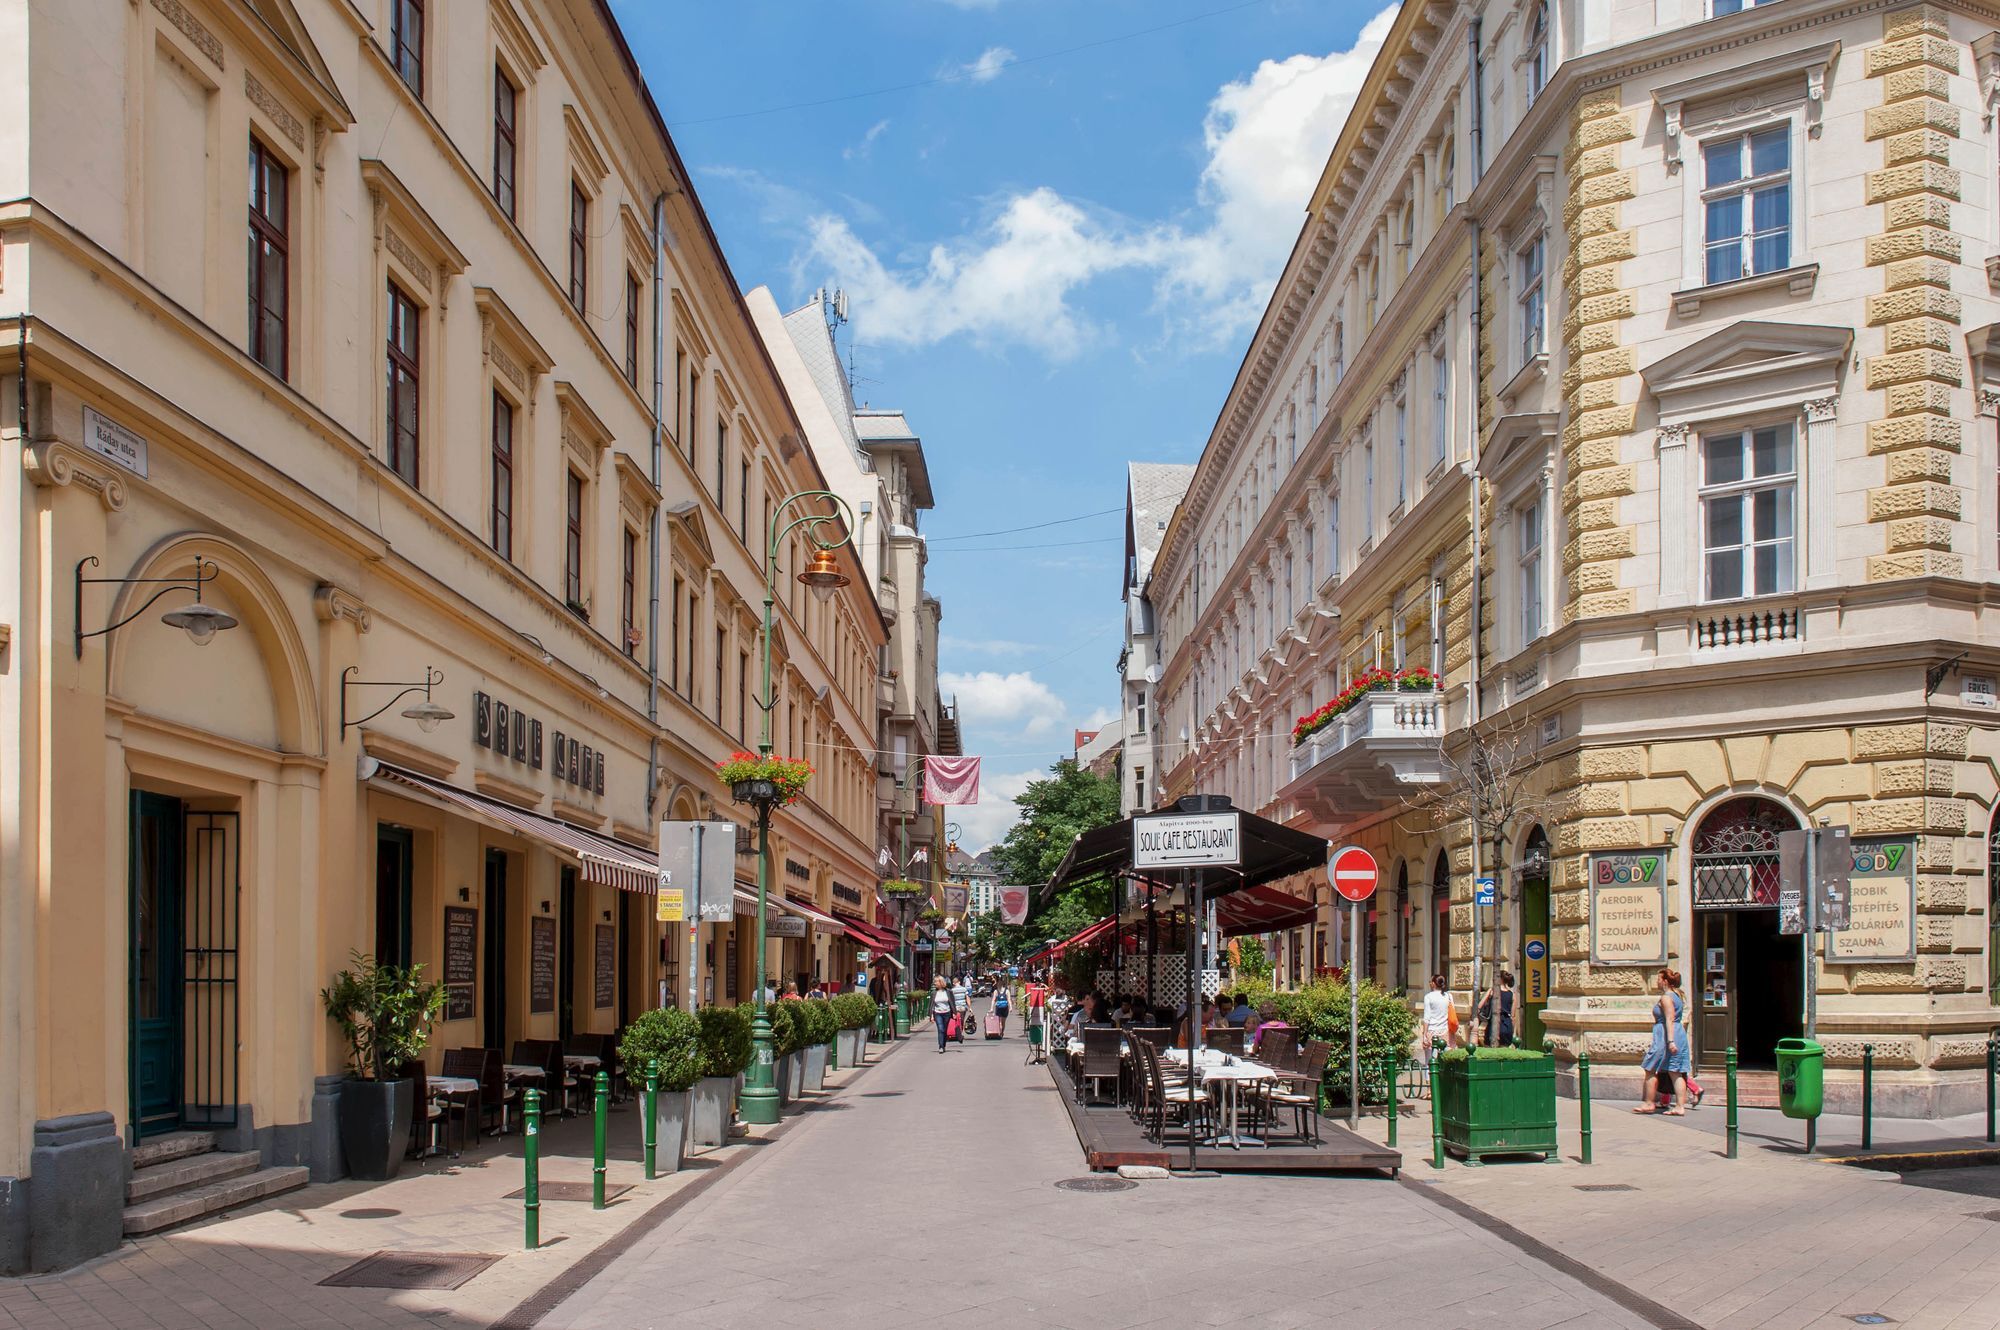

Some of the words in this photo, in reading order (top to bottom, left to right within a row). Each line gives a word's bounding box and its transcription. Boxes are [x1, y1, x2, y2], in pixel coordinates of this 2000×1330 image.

[97, 426, 118, 451] Ráday
[121, 443, 136, 459] utca
[1968, 682, 1991, 694] ERKEL
[479, 693, 542, 767] SOUL
[1140, 833, 1161, 852] SOUL
[1162, 831, 1181, 850] CAFE
[1183, 828, 1233, 849] RESTAURANT
[1854, 845, 1881, 853] SUN
[1613, 856, 1637, 866] SUN
[1850, 845, 1905, 872] ODY
[1597, 857, 1659, 884] BODY
[1851, 886, 1888, 896] ROBIK
[1601, 895, 1644, 905] AEROBIK
[1601, 908, 1653, 920] TESTÉPÍTÉS
[1851, 903, 1899, 914] STÉPÍTÉS
[1601, 925, 1658, 936] SZOLÁRIUM
[1850, 920, 1904, 930] OLÁRIUM
[1601, 943, 1641, 952] SZAUNA
[1839, 938, 1885, 948] SZAUNA
[1532, 969, 1541, 997] ATM
